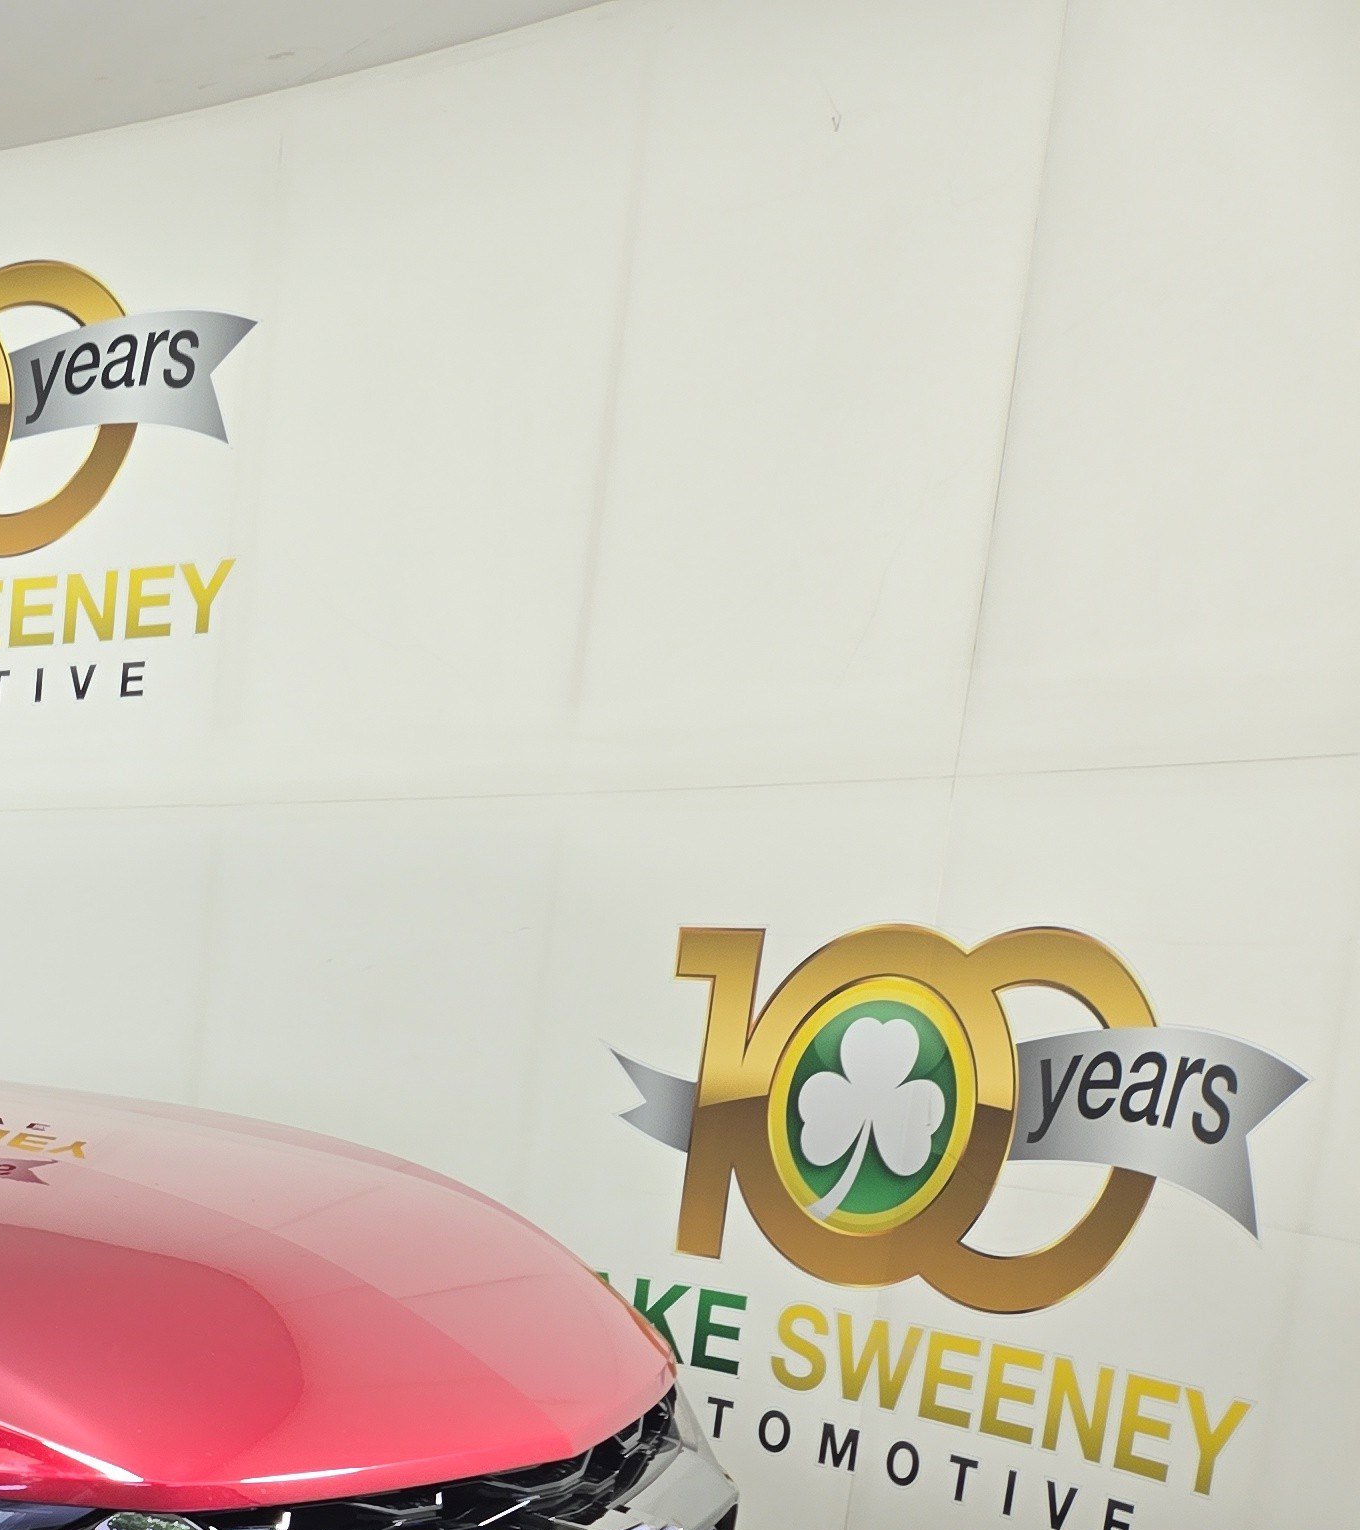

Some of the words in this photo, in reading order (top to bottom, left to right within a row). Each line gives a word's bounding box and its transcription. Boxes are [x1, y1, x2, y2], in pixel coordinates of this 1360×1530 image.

[24, 328, 201, 425] years
[1025, 1049, 1239, 1146] years
[770, 1303, 1252, 1496] SWEENEY
